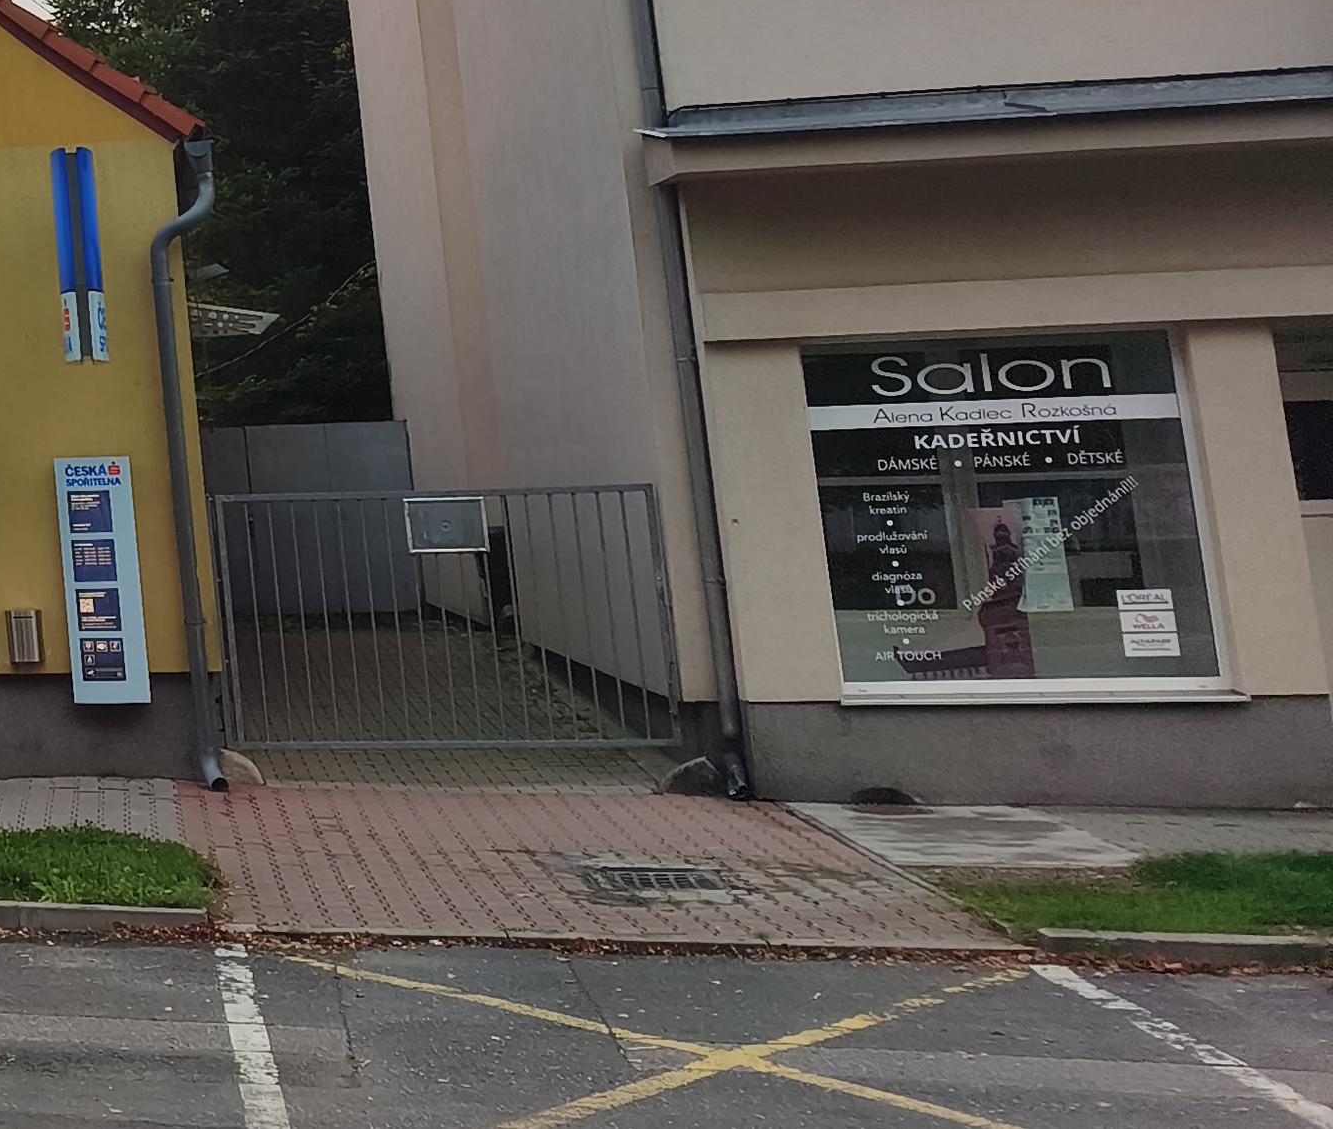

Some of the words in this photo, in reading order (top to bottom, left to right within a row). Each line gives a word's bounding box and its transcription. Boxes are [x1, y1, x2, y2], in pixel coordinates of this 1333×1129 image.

[870, 353, 1112, 397] Salon
[873, 408, 933, 424] Alena
[939, 405, 1013, 422] Kadlec
[1021, 402, 1117, 419] Rozkošná
[913, 425, 1081, 450] KADEŘNICTVÍ
[877, 456, 939, 471] DÁMSKÉ
[973, 452, 1032, 468] PÁNSKÉ
[1067, 449, 1124, 465] DĚTSKÉ
[65, 464, 108, 477] ČESKÁ
[66, 477, 121, 487] SPOŘITELNA
[862, 491, 910, 503] Brazilský
[869, 505, 907, 515] kreatin
[856, 530, 928, 544] prodlužování
[879, 544, 907, 555] vlasů
[961, 575, 1007, 612] Pánské
[1004, 543, 1051, 581] stříhání
[1047, 527, 1073, 548] bez
[871, 571, 923, 584] diagnóza
[866, 609, 939, 623] trichologická
[883, 624, 926, 635] kamera
[875, 651, 895, 661] AIR
[897, 650, 942, 661] TOUCH
